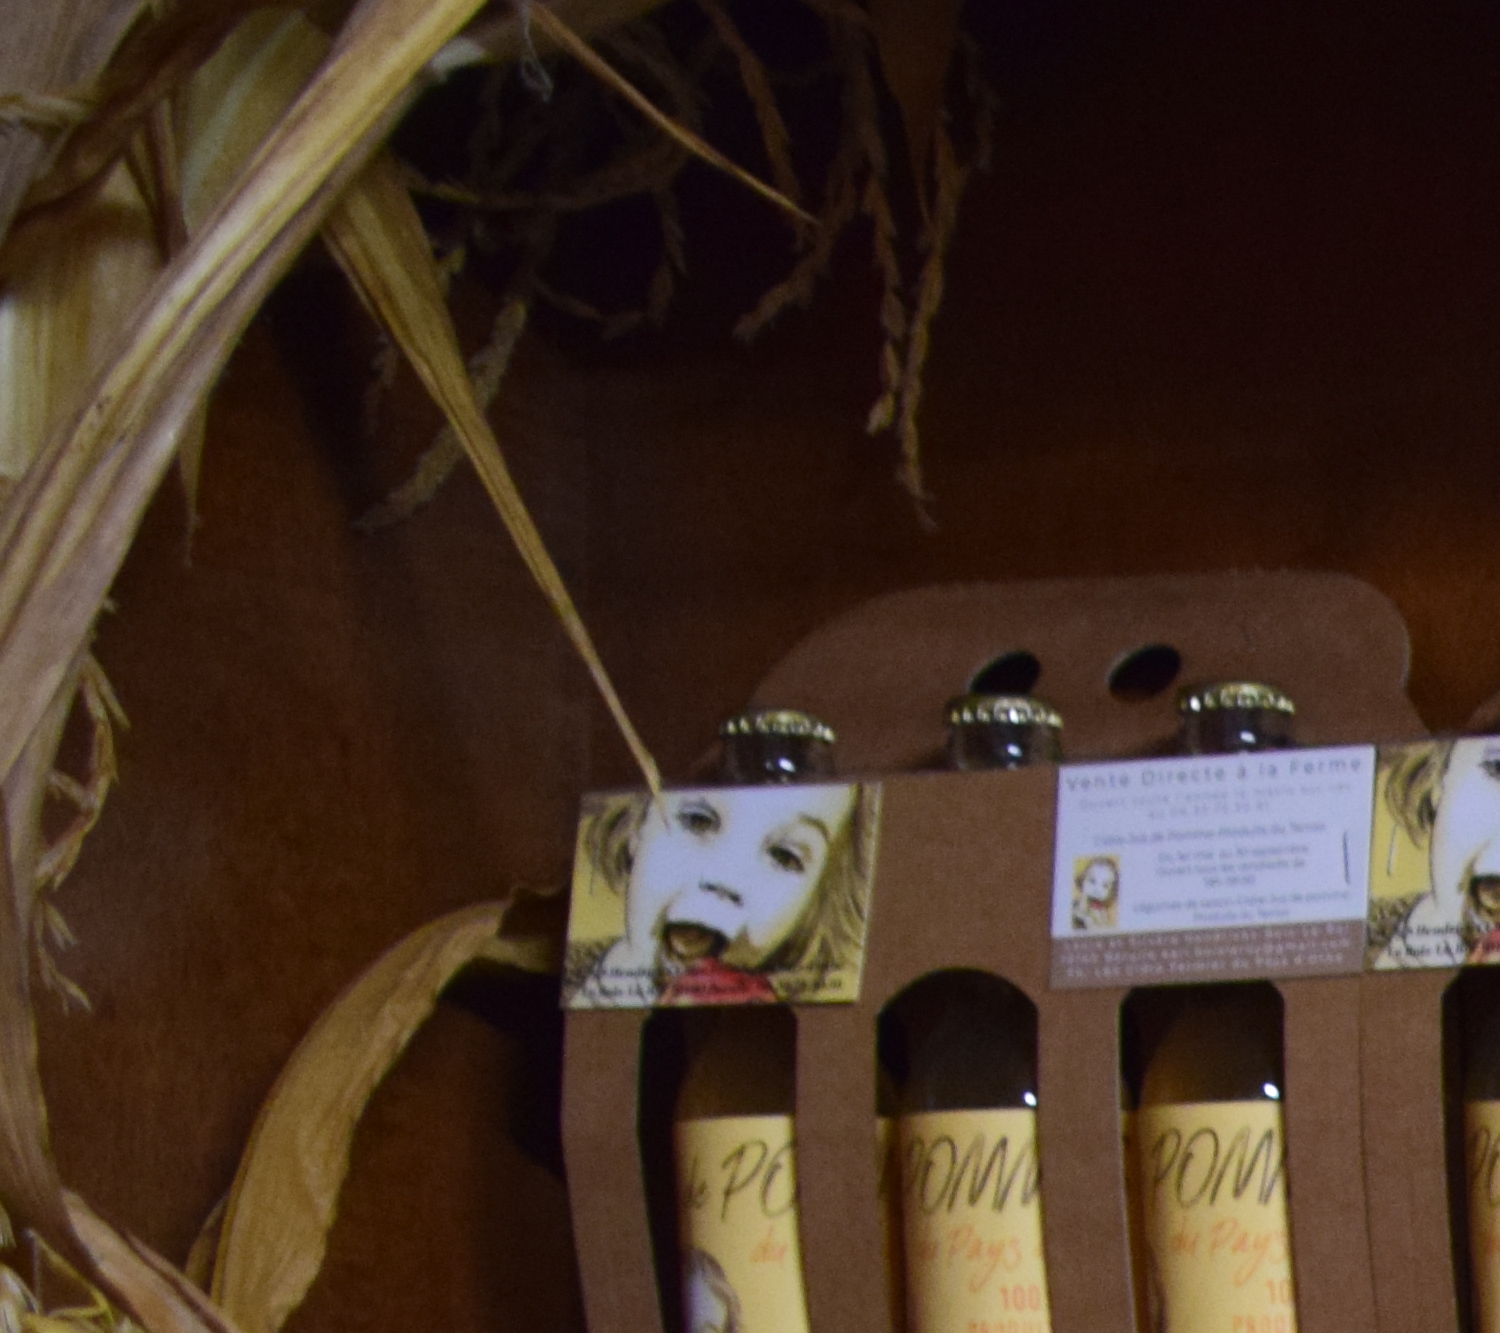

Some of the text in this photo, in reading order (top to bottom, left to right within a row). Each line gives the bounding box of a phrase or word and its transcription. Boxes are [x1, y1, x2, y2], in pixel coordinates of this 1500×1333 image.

[1067, 769, 1130, 791] Vente
[1141, 765, 1226, 787] Directe
[1258, 761, 1278, 778] la
[1290, 757, 1361, 775] Ferme
[949, 1226, 1022, 1293] Pays
[1209, 1217, 1288, 1286] Pays
